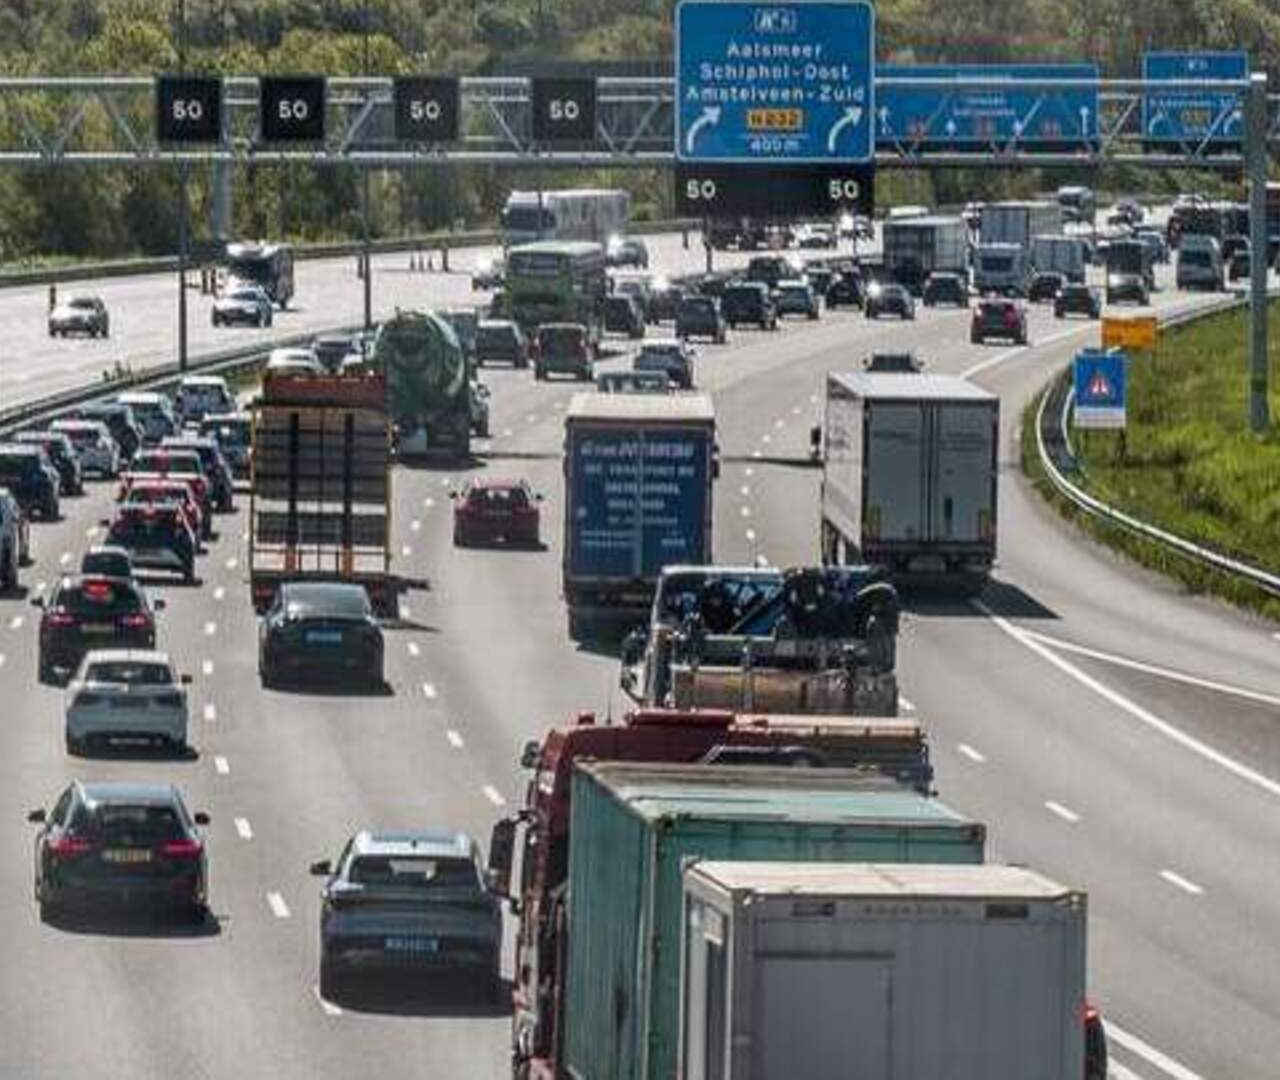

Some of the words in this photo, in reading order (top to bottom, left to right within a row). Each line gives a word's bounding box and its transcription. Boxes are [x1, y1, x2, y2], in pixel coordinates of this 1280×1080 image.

[728, 42, 822, 58] Aalsmeer
[700, 63, 850, 82] Schiphol-Oost
[686, 86, 865, 102] Amstelveen-Zuid
[173, 101, 202, 118] 50
[279, 101, 308, 118] 50
[410, 101, 440, 118] 50
[549, 101, 579, 118] 50
[686, 179, 716, 199] 50
[829, 179, 859, 199] 50
